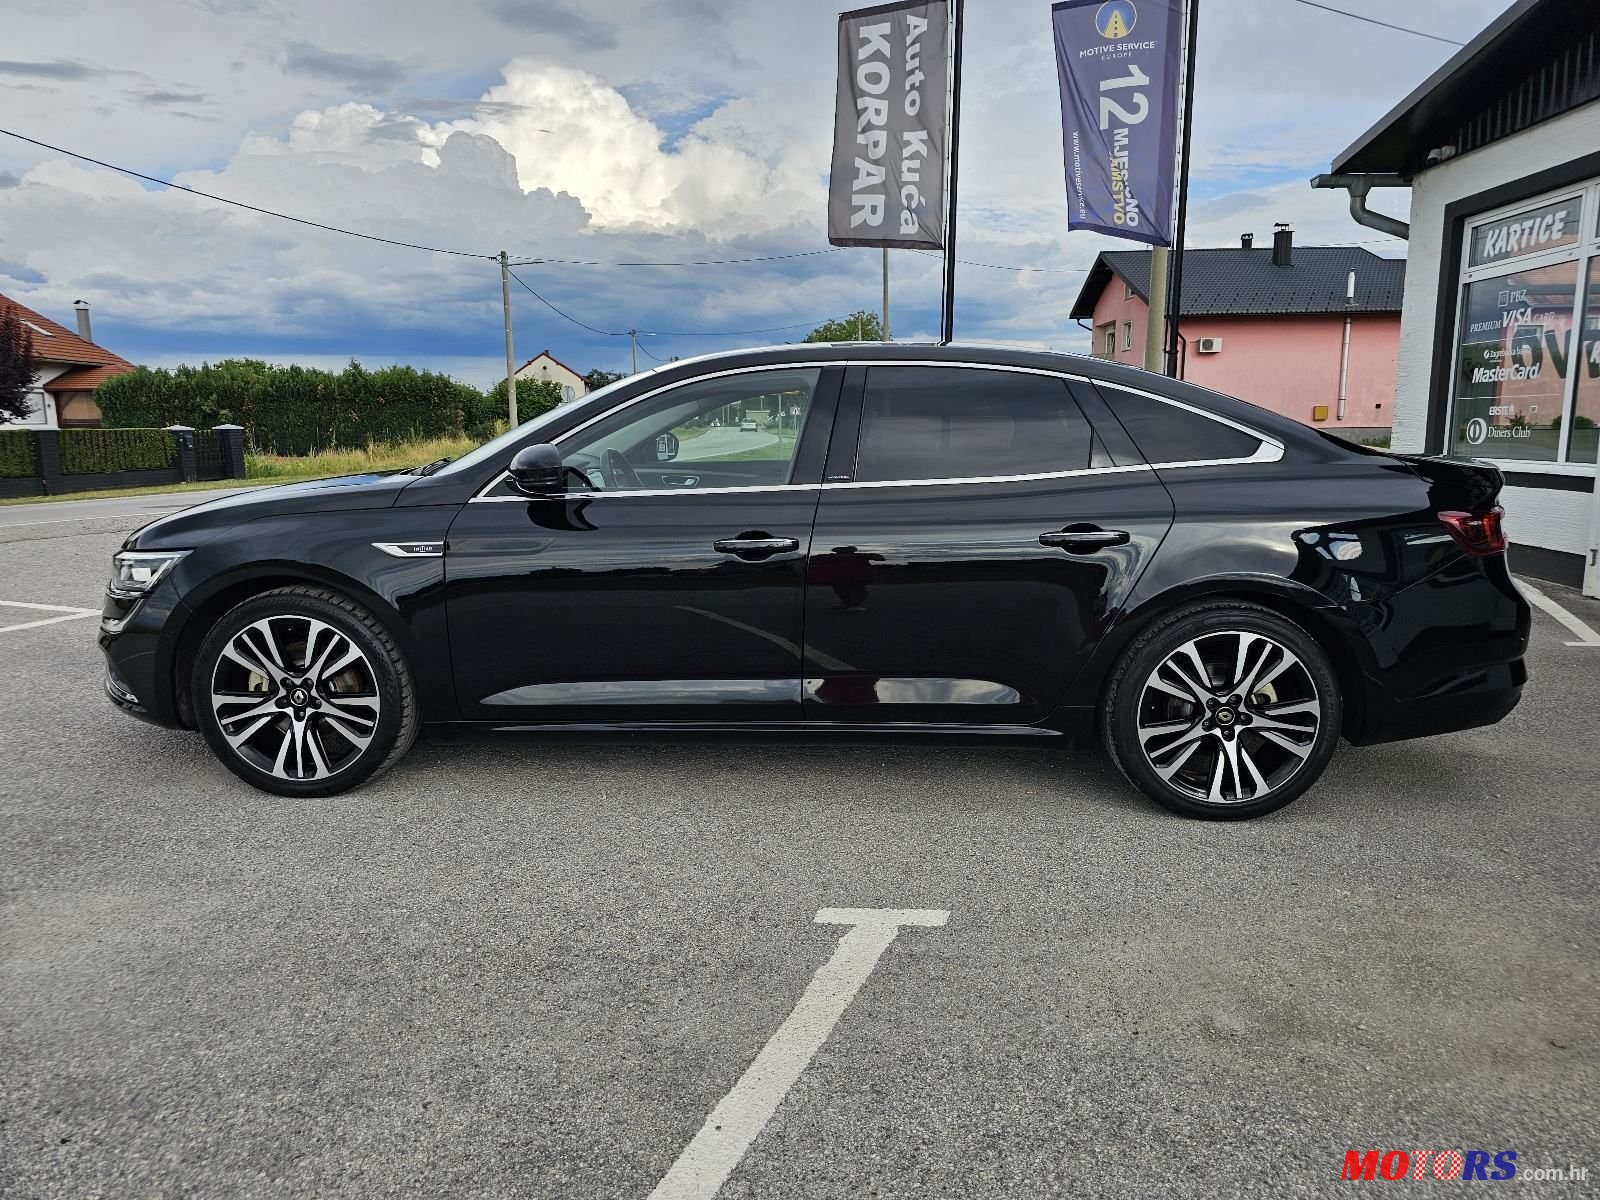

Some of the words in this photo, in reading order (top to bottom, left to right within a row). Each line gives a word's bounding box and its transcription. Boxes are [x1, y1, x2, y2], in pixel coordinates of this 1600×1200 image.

[904, 14, 928, 116] Auto
[1079, 44, 1115, 58] MOTIVE
[1117, 41, 1155, 51] SERVICE
[1101, 51, 1133, 61] EUROPE
[1099, 64, 1150, 130] 12
[850, 22, 892, 229] KORPAR
[900, 130, 928, 235] Kuća
[1113, 127, 1139, 227] MJESNO
[1483, 210, 1568, 258] KARTICE
[1510, 289, 1528, 303] PBZ
[1469, 319, 1502, 332] PREMIUM
[1502, 307, 1532, 328] VISA
[1533, 311, 1555, 322] CARD
[1471, 362, 1540, 383] MasterCard
[1488, 426, 1511, 438] Diners
[1512, 425, 1531, 438] Club
